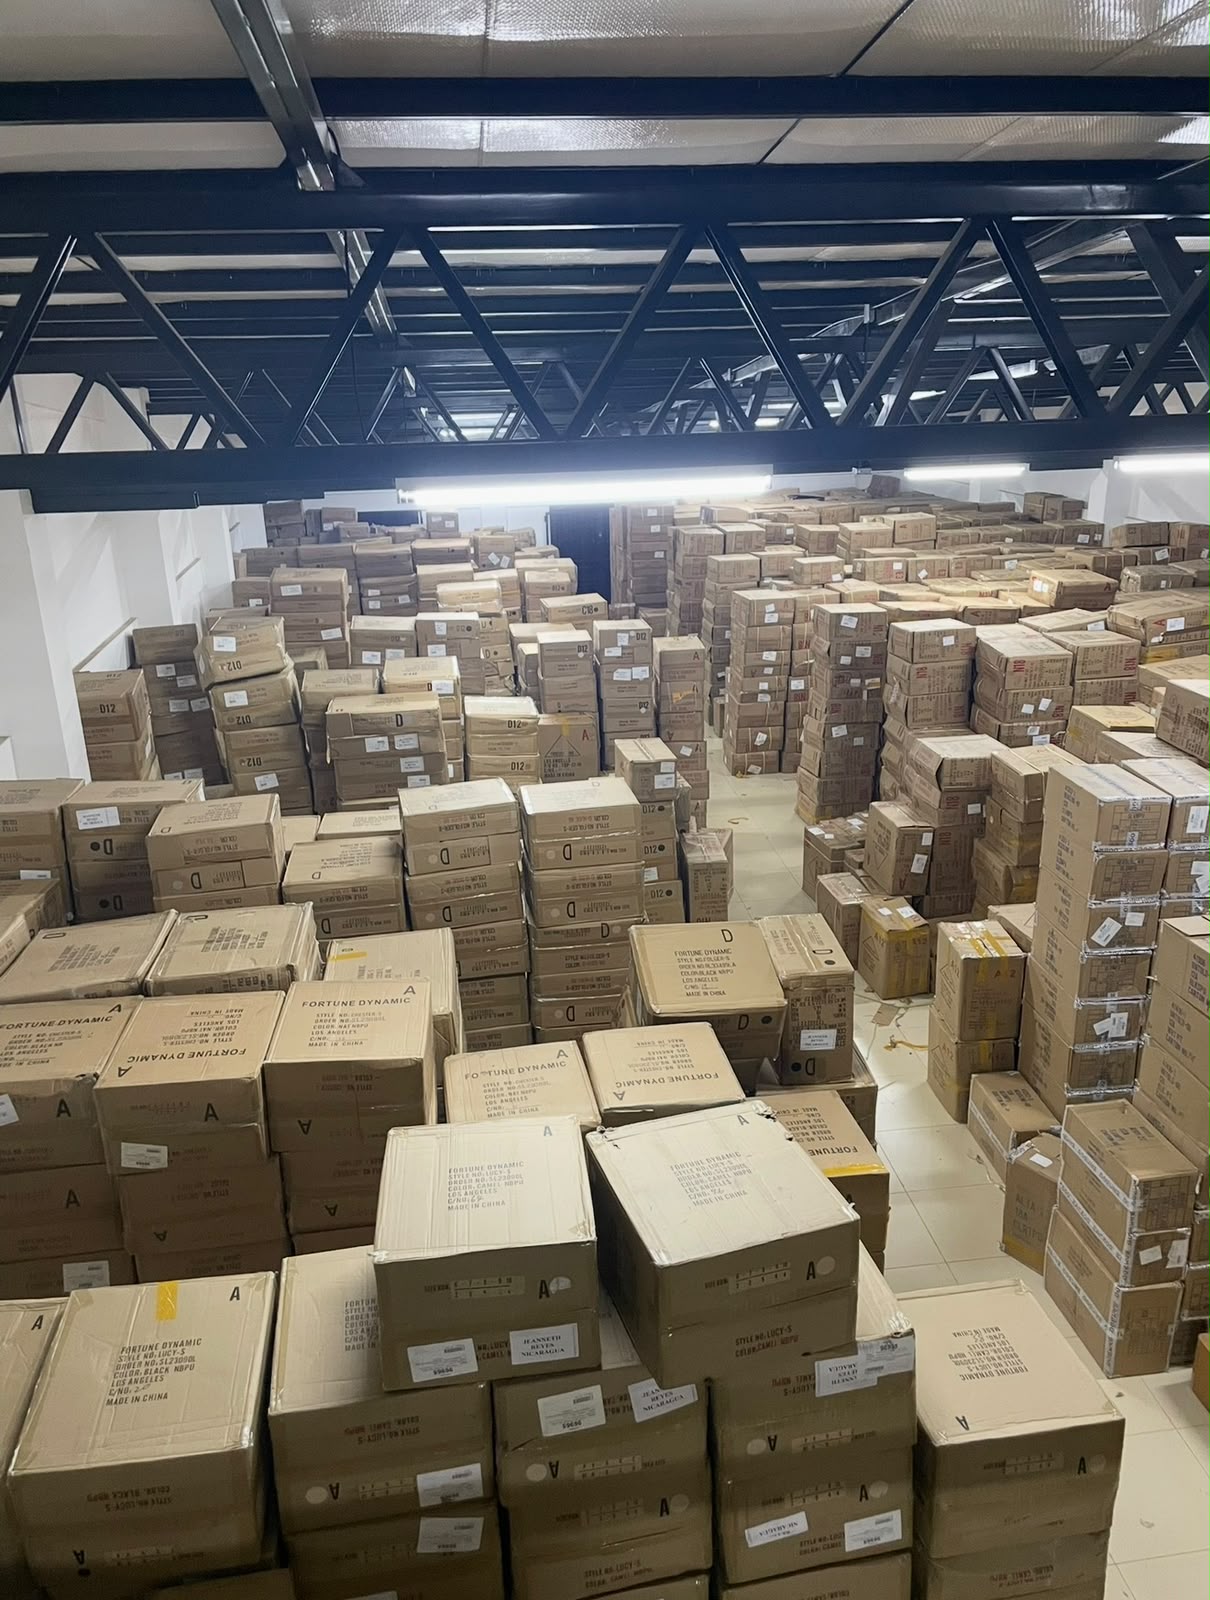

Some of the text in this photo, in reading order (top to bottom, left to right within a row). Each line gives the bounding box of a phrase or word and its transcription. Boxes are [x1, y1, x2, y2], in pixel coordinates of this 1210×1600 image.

[395, 714, 404, 727] D
[582, 730, 589, 740] A
[103, 839, 113, 855] D
[563, 844, 572, 861] D
[440, 848, 450, 865] D
[190, 872, 201, 890] D
[113, 896, 122, 911] D
[567, 901, 576, 918] D
[442, 906, 452, 922] D
[321, 918, 331, 934] D
[601, 923, 610, 938] D
[721, 929, 734, 942] D
[403, 986, 416, 995] A
[108, 1004, 121, 1013] A
[302, 998, 411, 1008] FORTUNE DYNAMIC
[57, 1016, 112, 1026] DYNAMIC
[566, 1005, 575, 1022] D
[738, 1015, 749, 1030] D
[127, 1048, 246, 1063] FORTUNE DYNAMIC
[556, 1049, 568, 1059] A
[118, 1066, 132, 1077] A
[465, 1061, 567, 1080] FOTUNE DYNAMIC
[806, 1058, 815, 1076] D
[615, 1072, 719, 1088] FORTUNE DYNAMIC
[613, 1091, 625, 1101] A
[55, 1099, 72, 1119] A
[204, 1103, 219, 1122] A
[297, 1119, 313, 1136] A
[736, 1114, 749, 1126] A
[543, 1125, 552, 1136] A
[706, 1152, 741, 1164] DYNAMIC
[808, 1146, 858, 1156] FORTUNE
[449, 1161, 524, 1174] FORTUNE DYNAMIC
[65, 1190, 81, 1209] A
[464, 1188, 497, 1196] ANGELES
[724, 1190, 748, 1201] CHINA
[324, 1205, 339, 1218] A
[482, 1200, 506, 1208] CHINA
[153, 1230, 167, 1243] A
[806, 1261, 817, 1281] A
[230, 1286, 241, 1301] A
[538, 1279, 550, 1300] A
[345, 1298, 377, 1308] FORTUN
[31, 1314, 44, 1331] A
[952, 1330, 973, 1338] CHINA
[120, 1338, 202, 1355] FORTUNE DYNAMIC
[521, 1348, 565, 1357] NICARAGUA
[116, 1361, 142, 1371] ORDER
[118, 1354, 140, 1363] STYLE
[174, 1364, 195, 1372] NBPU
[959, 1366, 1028, 1381] FORTUNE DYNAMIC
[111, 1375, 164, 1387] LOS ANGELES
[106, 1392, 168, 1406] MADE IN CHINA
[643, 1394, 684, 1411] NICARAGUA
[955, 1415, 970, 1431] A
[767, 1434, 778, 1452] A
[548, 1461, 560, 1479] A
[1078, 1457, 1086, 1475] A
[328, 1482, 340, 1500] A
[859, 1484, 869, 1502] A
[659, 1498, 670, 1517] A
[73, 1550, 85, 1565] A
